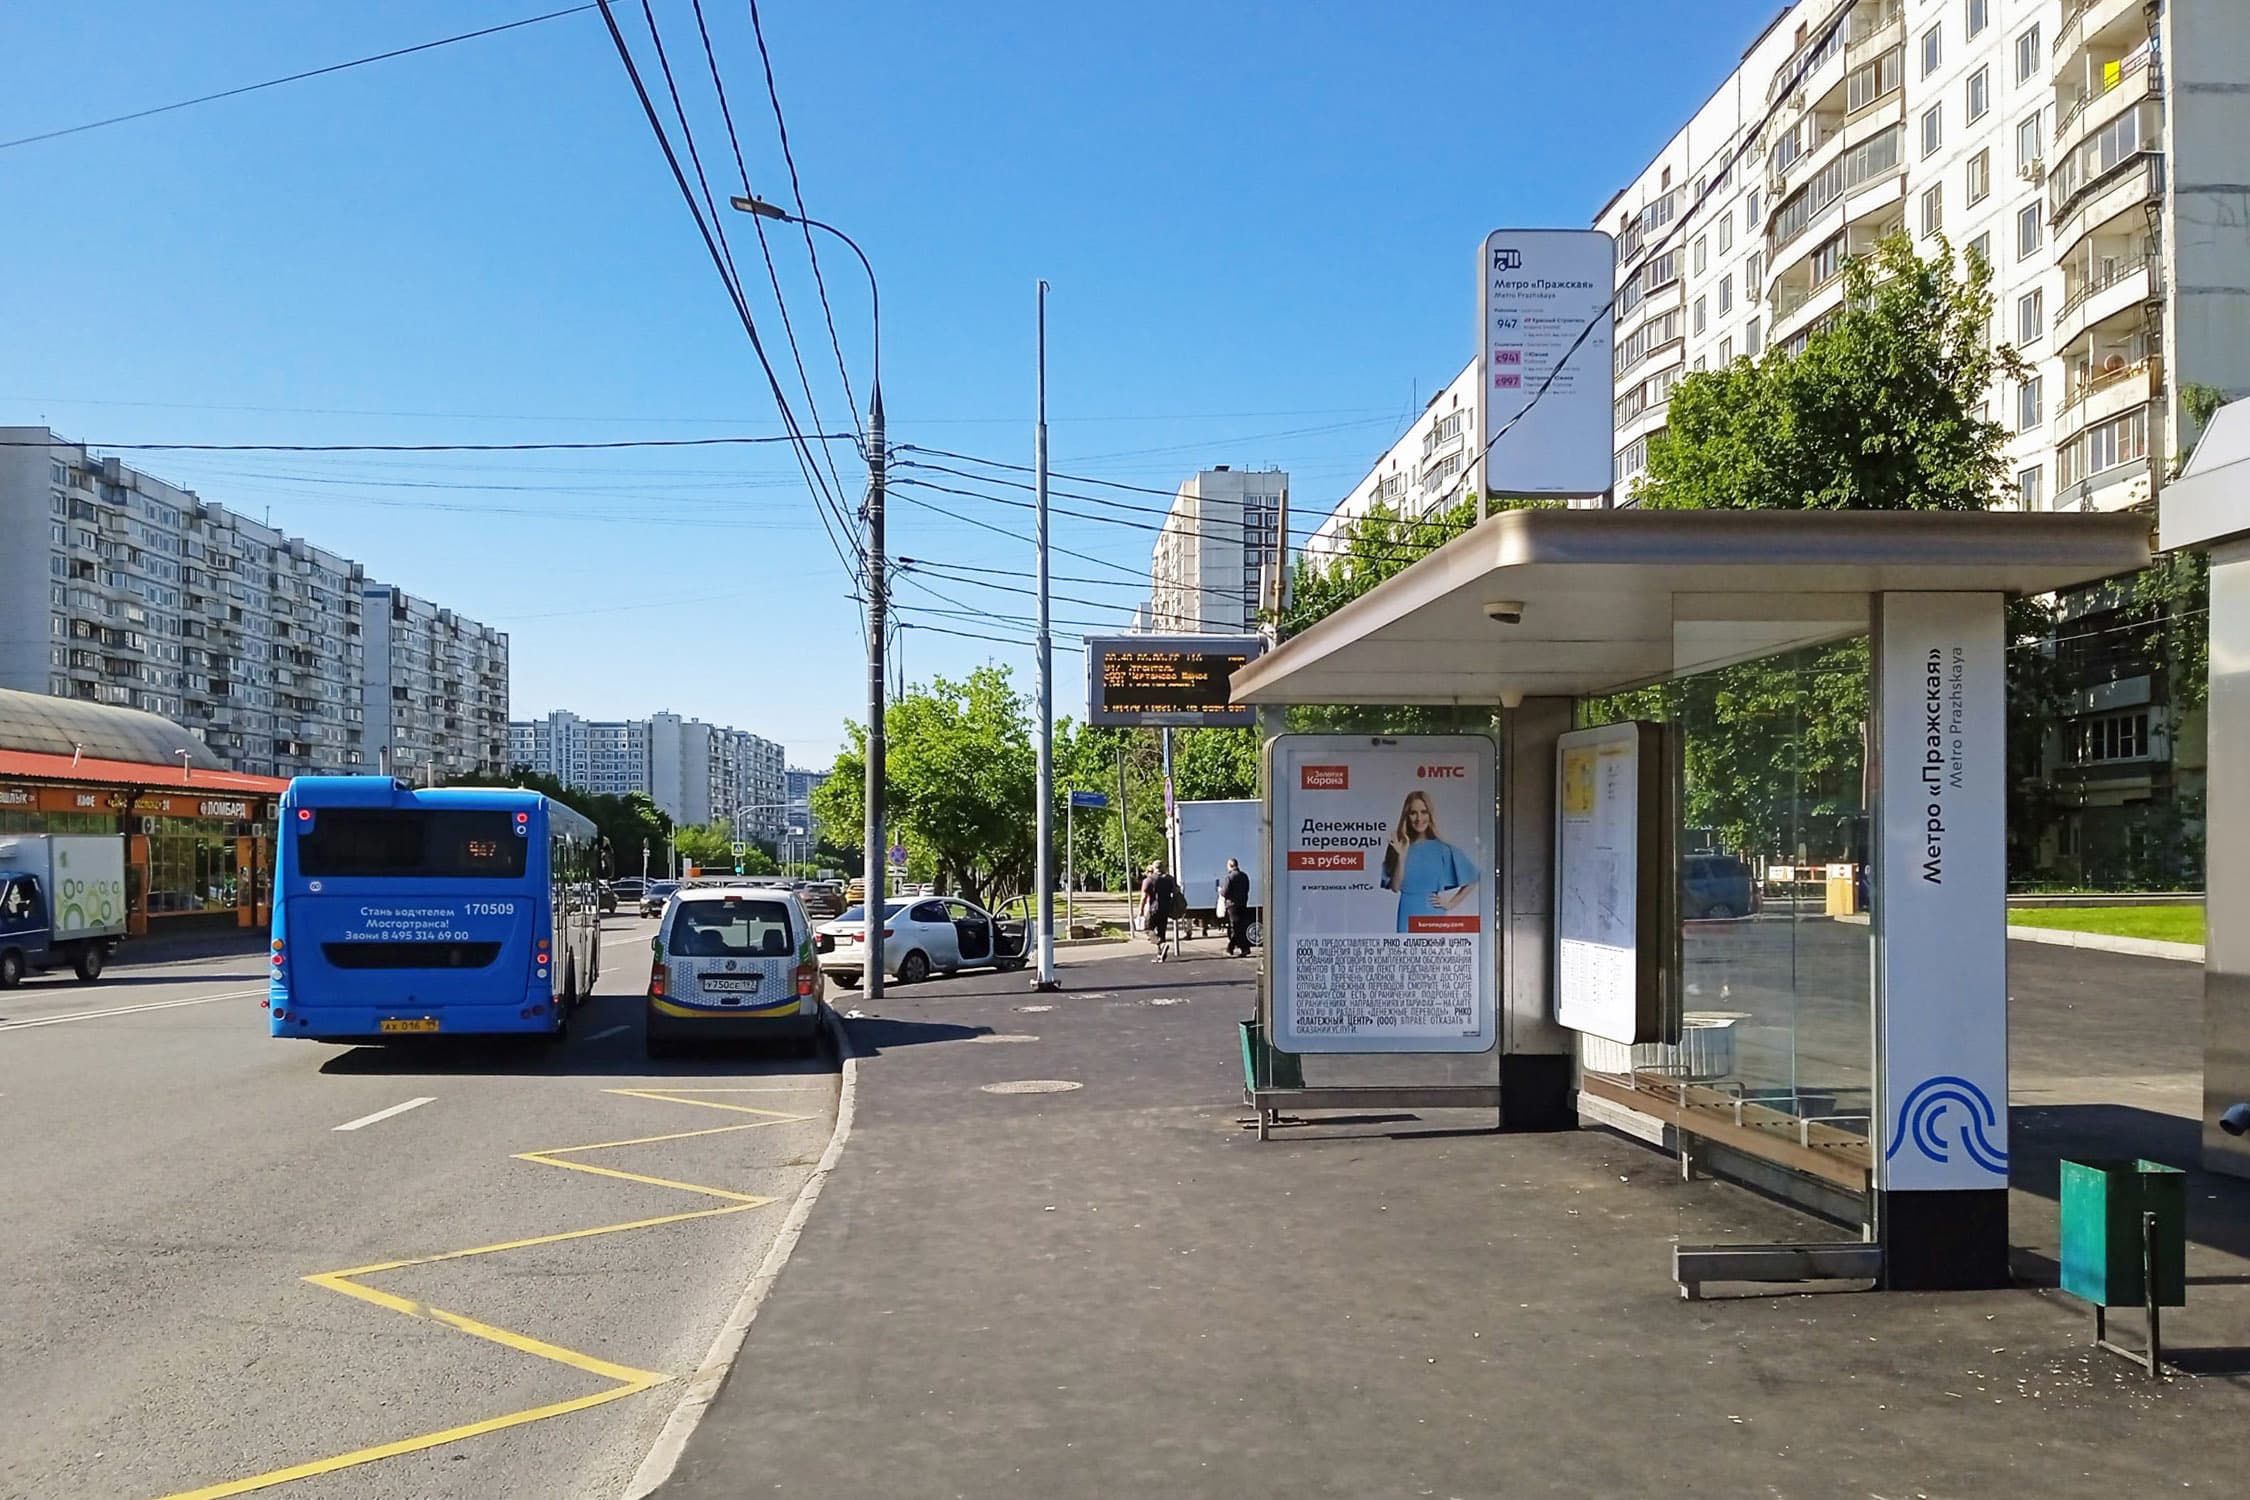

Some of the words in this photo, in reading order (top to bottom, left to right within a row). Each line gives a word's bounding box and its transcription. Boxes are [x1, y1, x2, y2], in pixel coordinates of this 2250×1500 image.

[1494, 279, 1530, 290] Метро
[1531, 279, 1594, 290] «Пражская»
[1497, 319, 1518, 329] 947
[1949, 646, 1966, 735] Prazhskaya
[1923, 648, 1945, 796] «Пражская»
[1949, 740, 1963, 789] Metro
[1428, 766, 1465, 778] МТС
[1306, 775, 1344, 787] Корона
[207, 800, 247, 819] ЛОМБАРД
[1301, 818, 1387, 834] Денежные
[1301, 836, 1382, 850] переводы
[1923, 803, 1945, 884] Метро
[1301, 856, 1316, 865] за
[1318, 854, 1358, 868] рубеж
[360, 906, 393, 917] Стань
[395, 907, 455, 917] водителем
[464, 903, 515, 915] 170509
[366, 919, 450, 930] Мосгортранса!
[345, 931, 379, 940] Звони
[381, 931, 389, 940] 8
[391, 931, 413, 940] 495
[415, 931, 435, 940] 314
[437, 931, 451, 940] 69
[454, 931, 469, 940] 00
